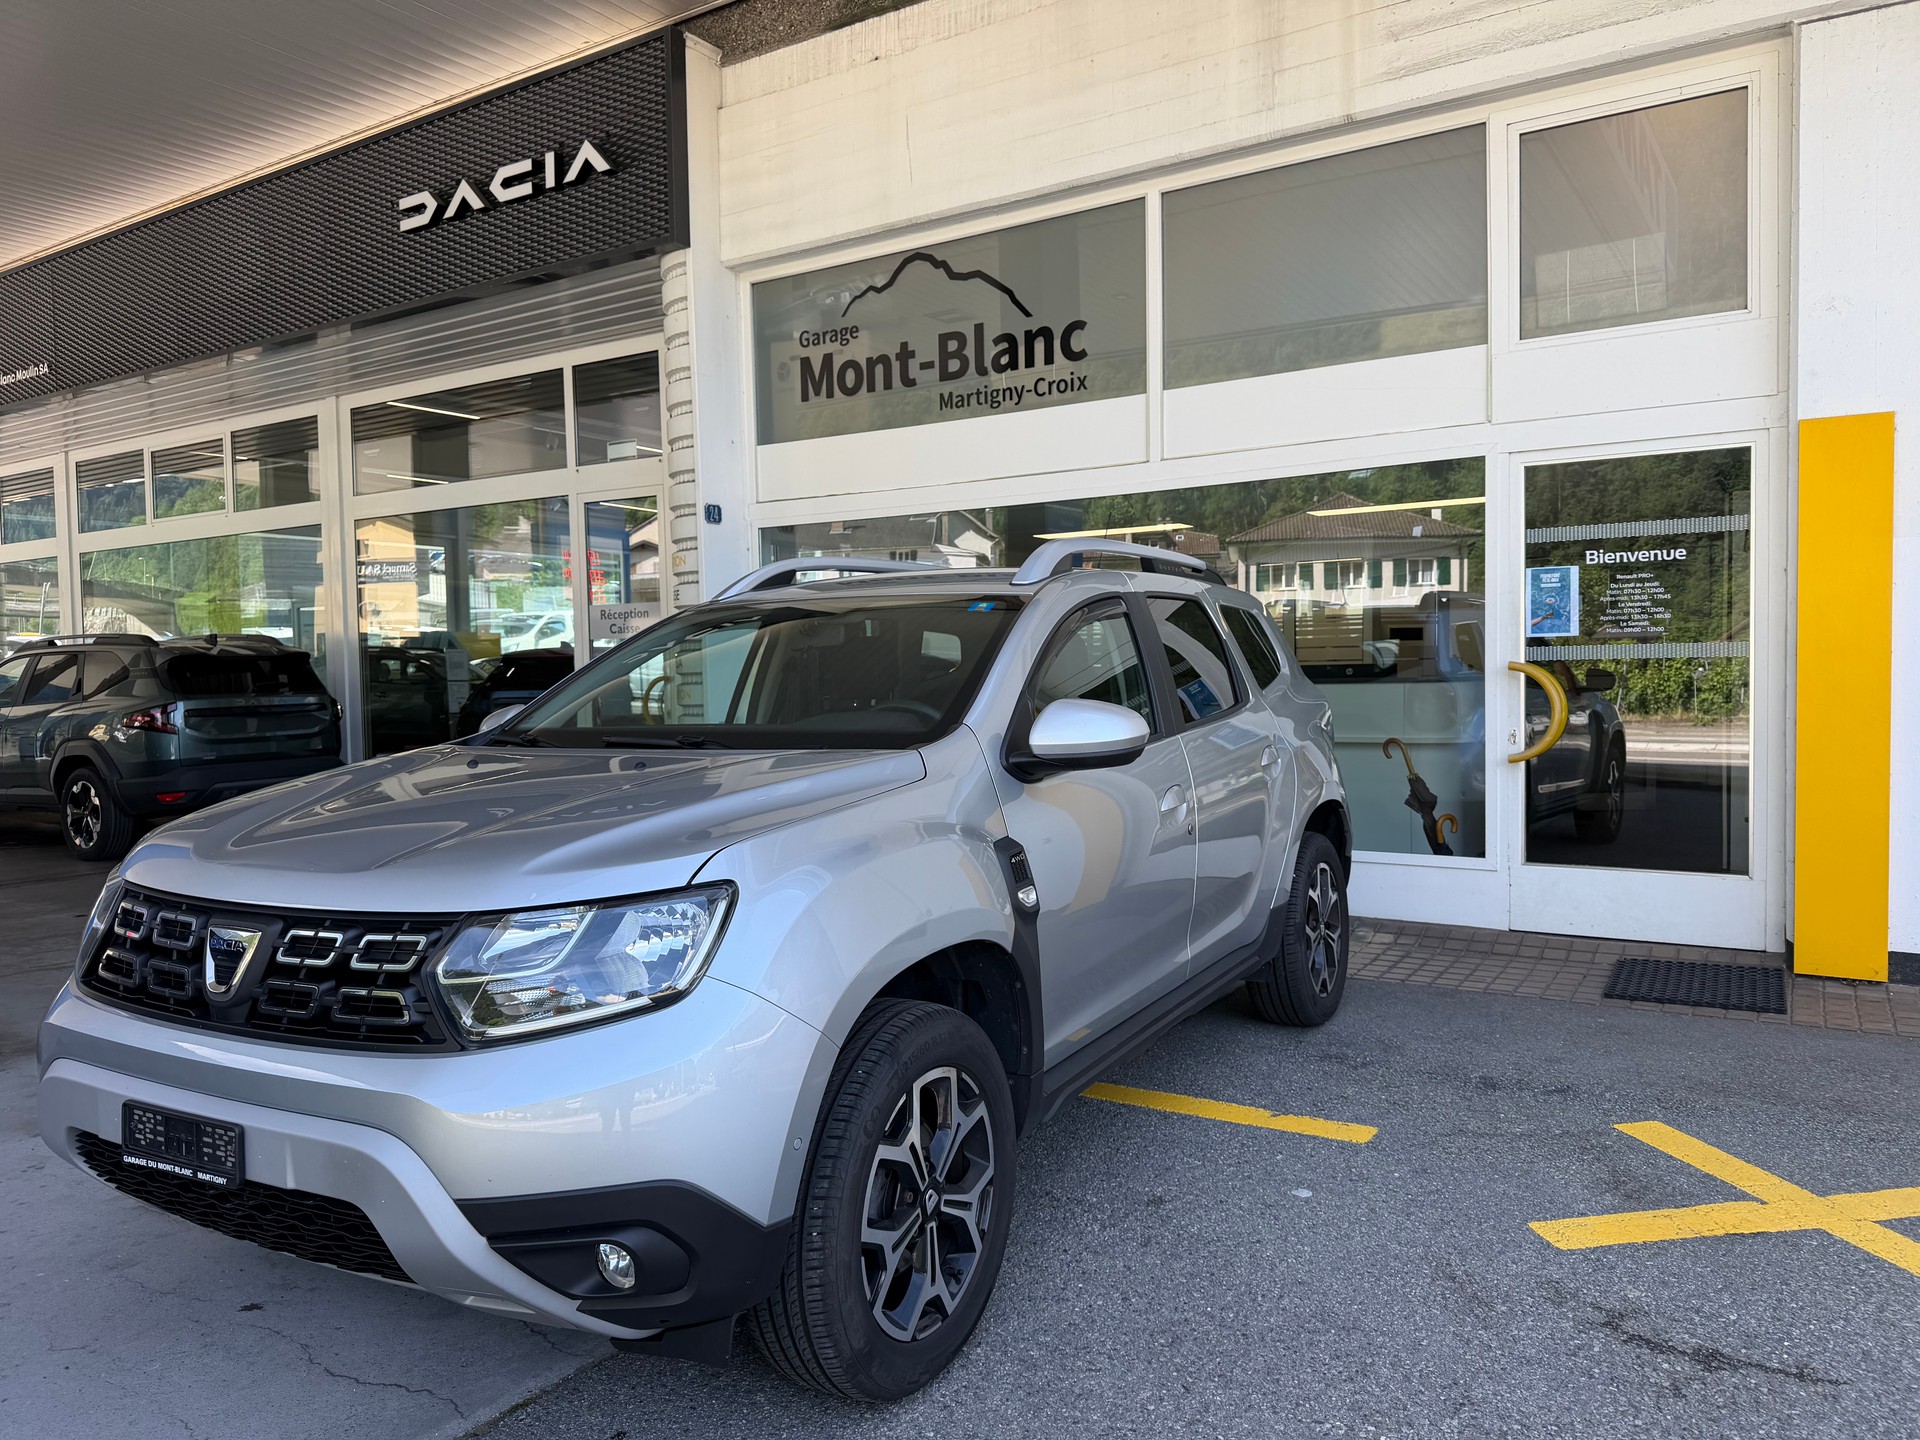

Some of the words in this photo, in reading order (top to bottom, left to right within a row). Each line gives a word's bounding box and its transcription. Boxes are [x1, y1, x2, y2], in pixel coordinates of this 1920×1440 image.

[399, 139, 612, 232] DACIA
[799, 324, 859, 348] Garage
[800, 319, 1088, 402] Mont-Blanc
[16, 364, 39, 381] Moulin
[39, 362, 49, 375] SA
[939, 371, 1088, 411] Martigny-Croix
[709, 505, 719, 522] 24
[1585, 548, 1687, 565] Bienvenue
[600, 608, 649, 622] Réception
[609, 623, 640, 634] Caisse
[1011, 853, 1026, 863] 4WD
[210, 936, 244, 952] DACIA
[123, 1155, 147, 1167] GARAGE
[147, 1160, 157, 1168] DU
[157, 1162, 194, 1177] MONT-BLANC
[197, 1171, 228, 1186] MARTIGNY
